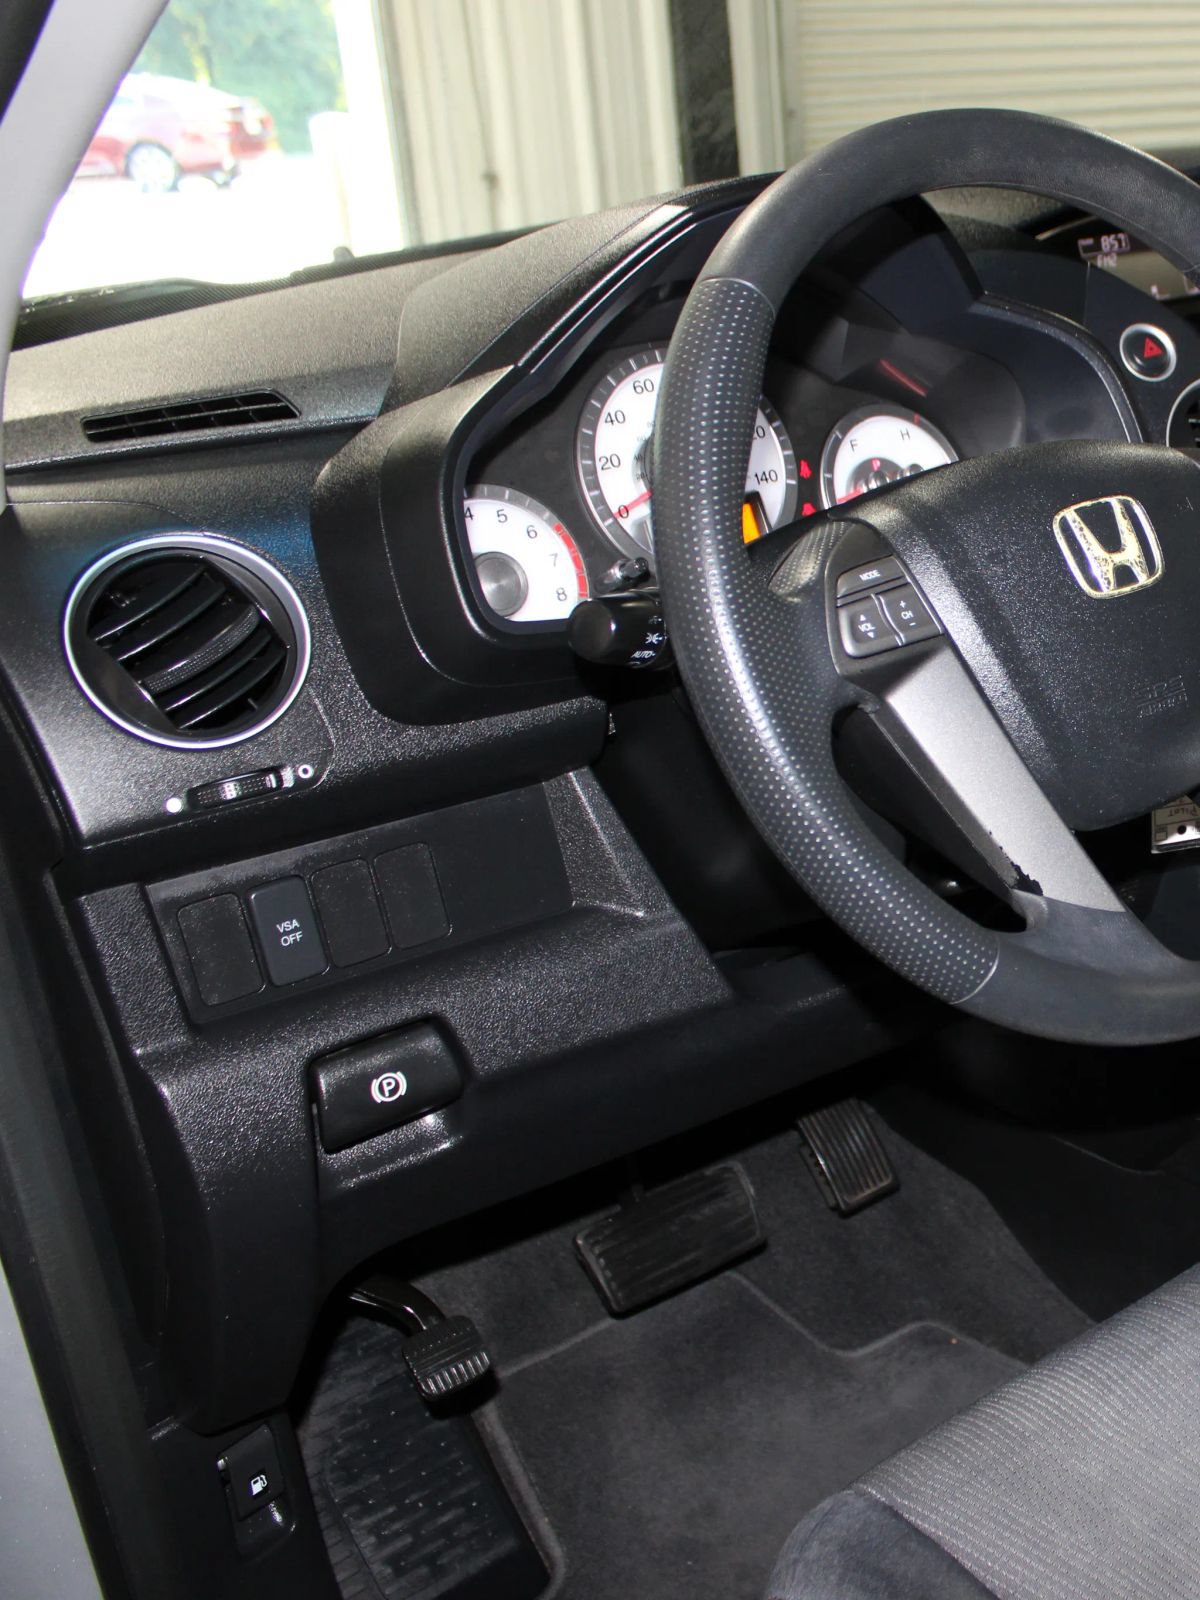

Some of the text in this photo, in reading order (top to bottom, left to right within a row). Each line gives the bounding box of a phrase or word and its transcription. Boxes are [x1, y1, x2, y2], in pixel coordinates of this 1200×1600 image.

[632, 378, 655, 394] 60
[604, 410, 626, 426] 40
[900, 428, 911, 441] H
[849, 439, 858, 452] F
[599, 453, 621, 471] 20
[754, 469, 778, 486] 140
[464, 502, 474, 521] 4
[496, 509, 508, 524] 5
[618, 505, 629, 519] 0
[526, 525, 538, 539] 6
[549, 553, 559, 567] 7
[859, 569, 881, 582] MODE
[555, 587, 567, 602] 8
[901, 610, 914, 621] CH
[858, 622, 876, 633] VOL
[631, 650, 655, 659] AUTO
[276, 918, 300, 933] VSA
[280, 931, 303, 947] OFF
